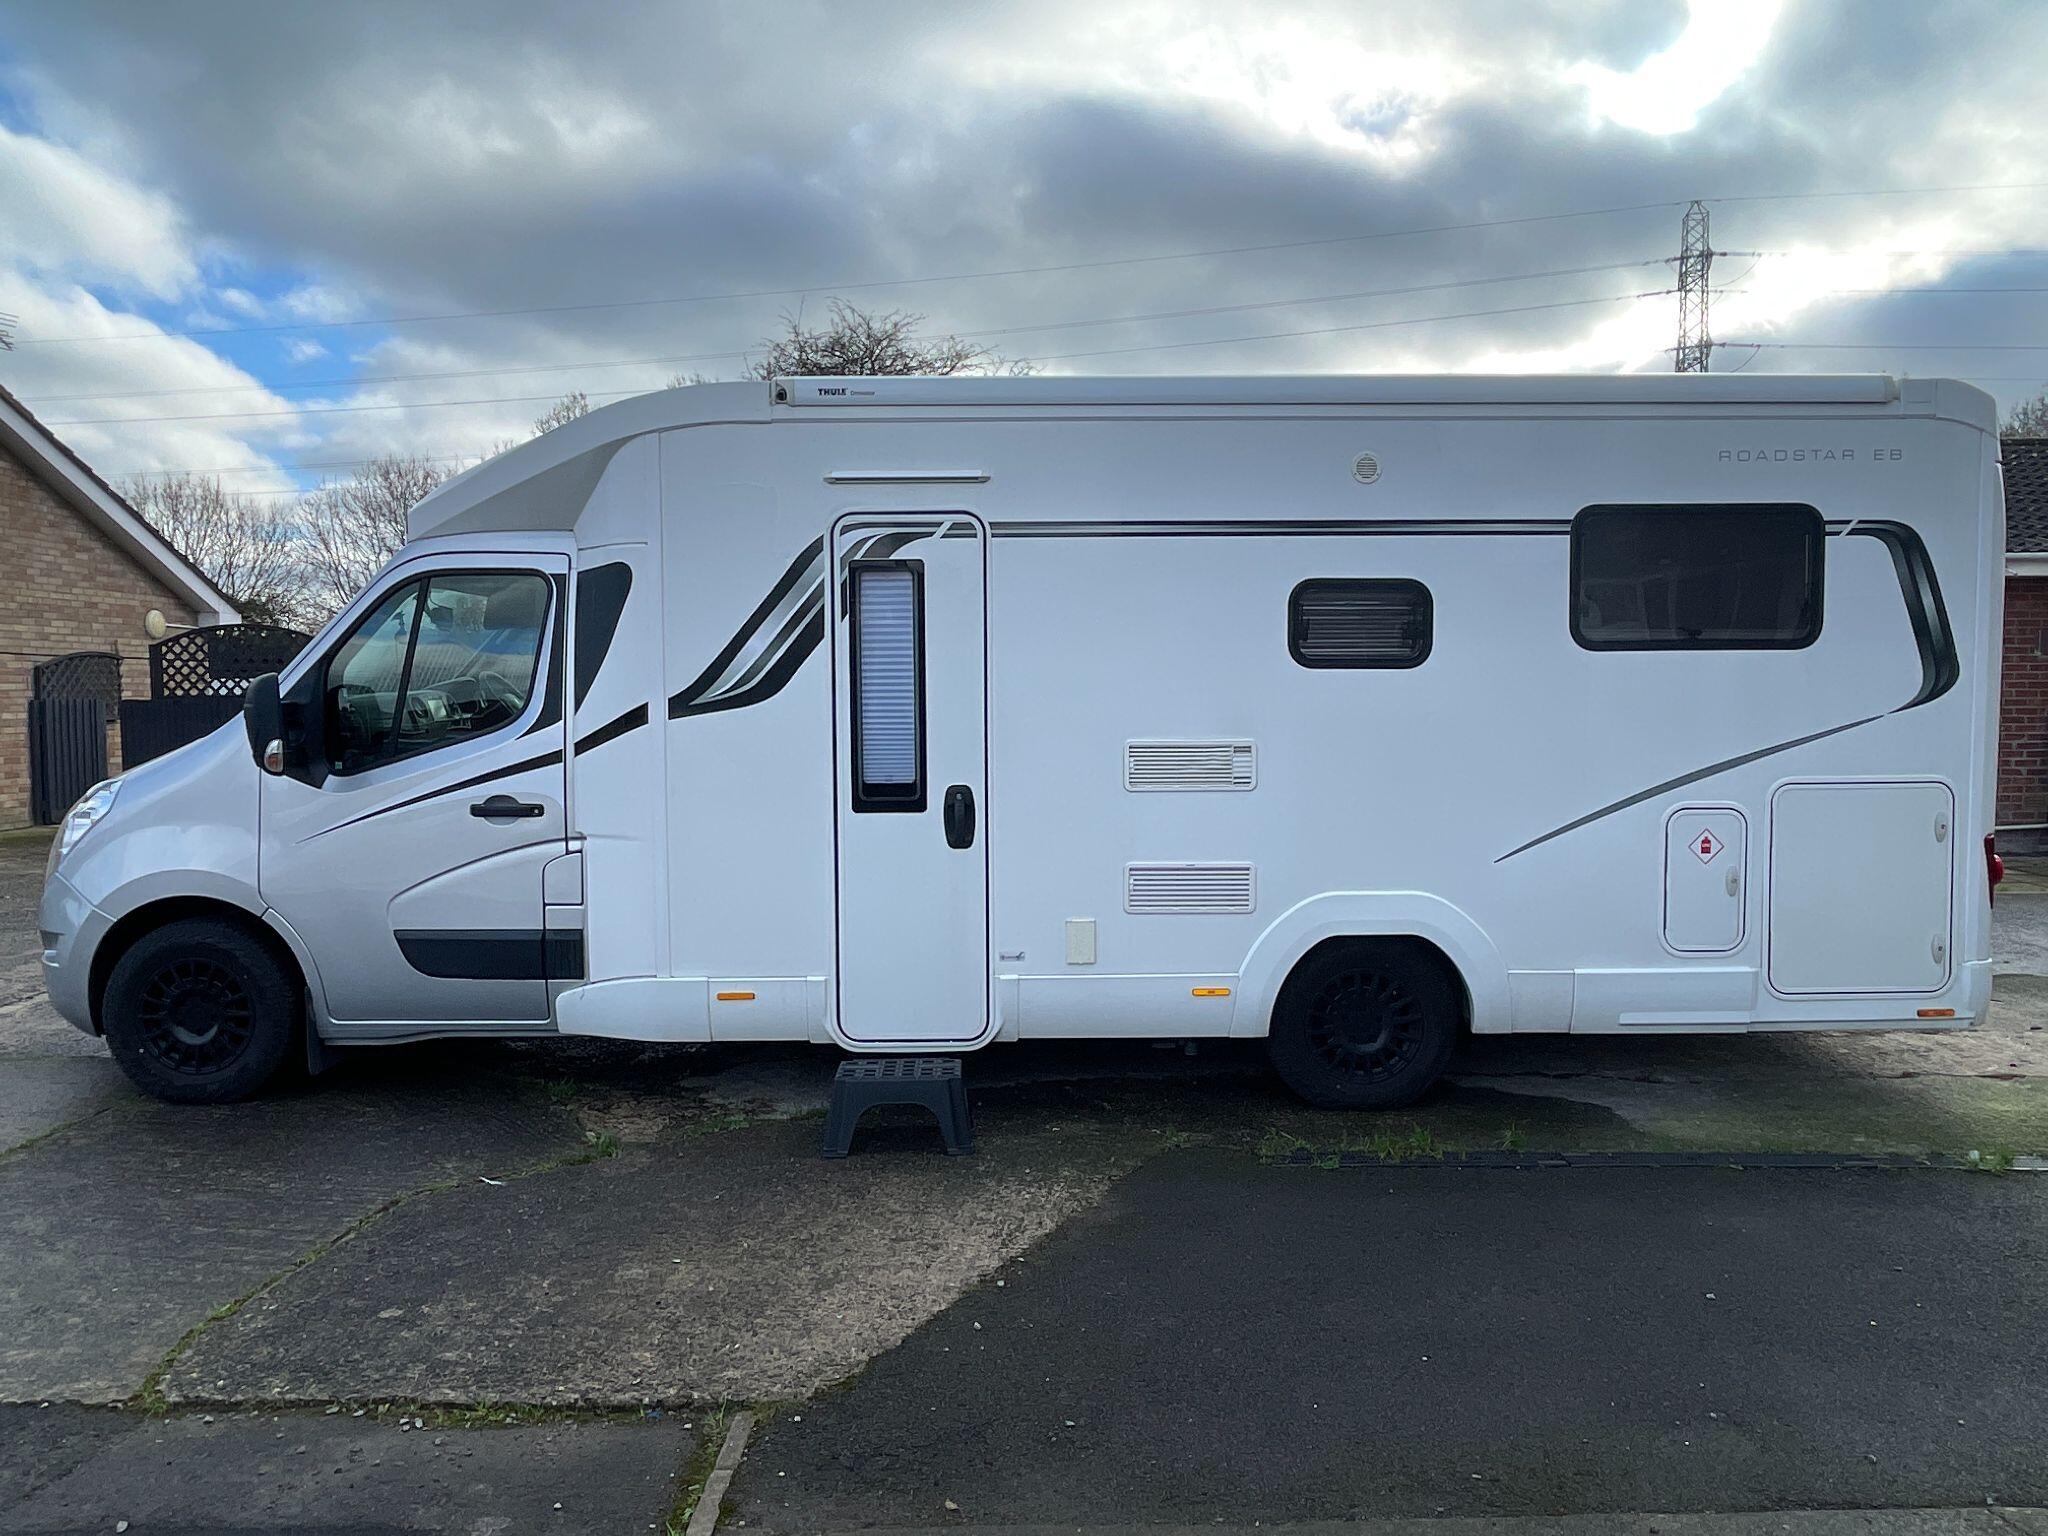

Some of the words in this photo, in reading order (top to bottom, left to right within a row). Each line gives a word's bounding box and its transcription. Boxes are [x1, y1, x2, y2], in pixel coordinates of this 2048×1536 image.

[818, 387, 847, 396] THULE
[1718, 449, 1855, 462] ROADSTAR
[1873, 449, 1903, 461] EB
